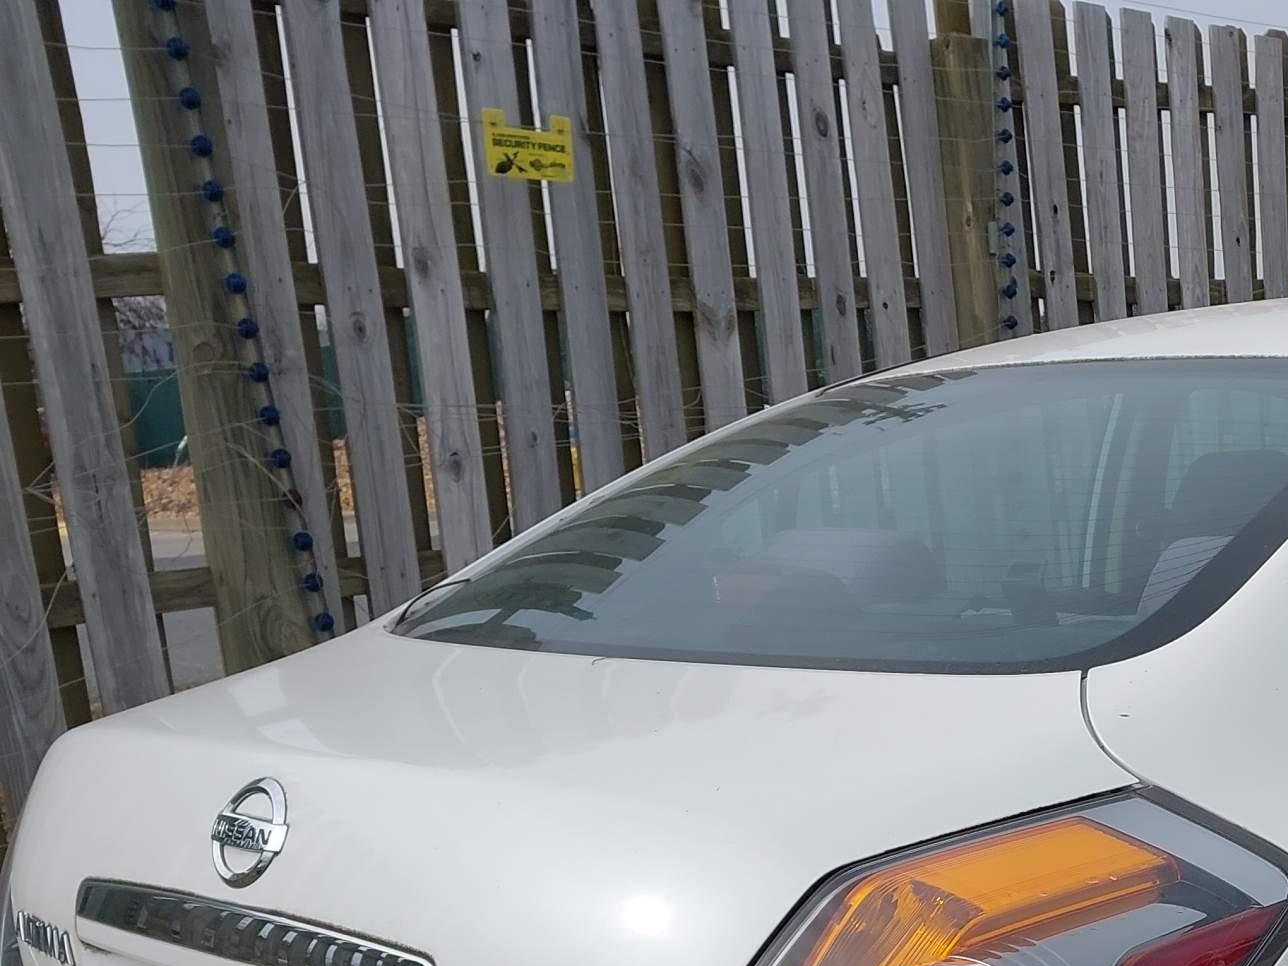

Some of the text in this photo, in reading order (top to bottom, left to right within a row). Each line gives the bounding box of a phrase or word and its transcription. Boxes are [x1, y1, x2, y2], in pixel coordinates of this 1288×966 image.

[492, 138, 566, 153] SECURITY FENCE
[213, 818, 272, 846] NISSAN
